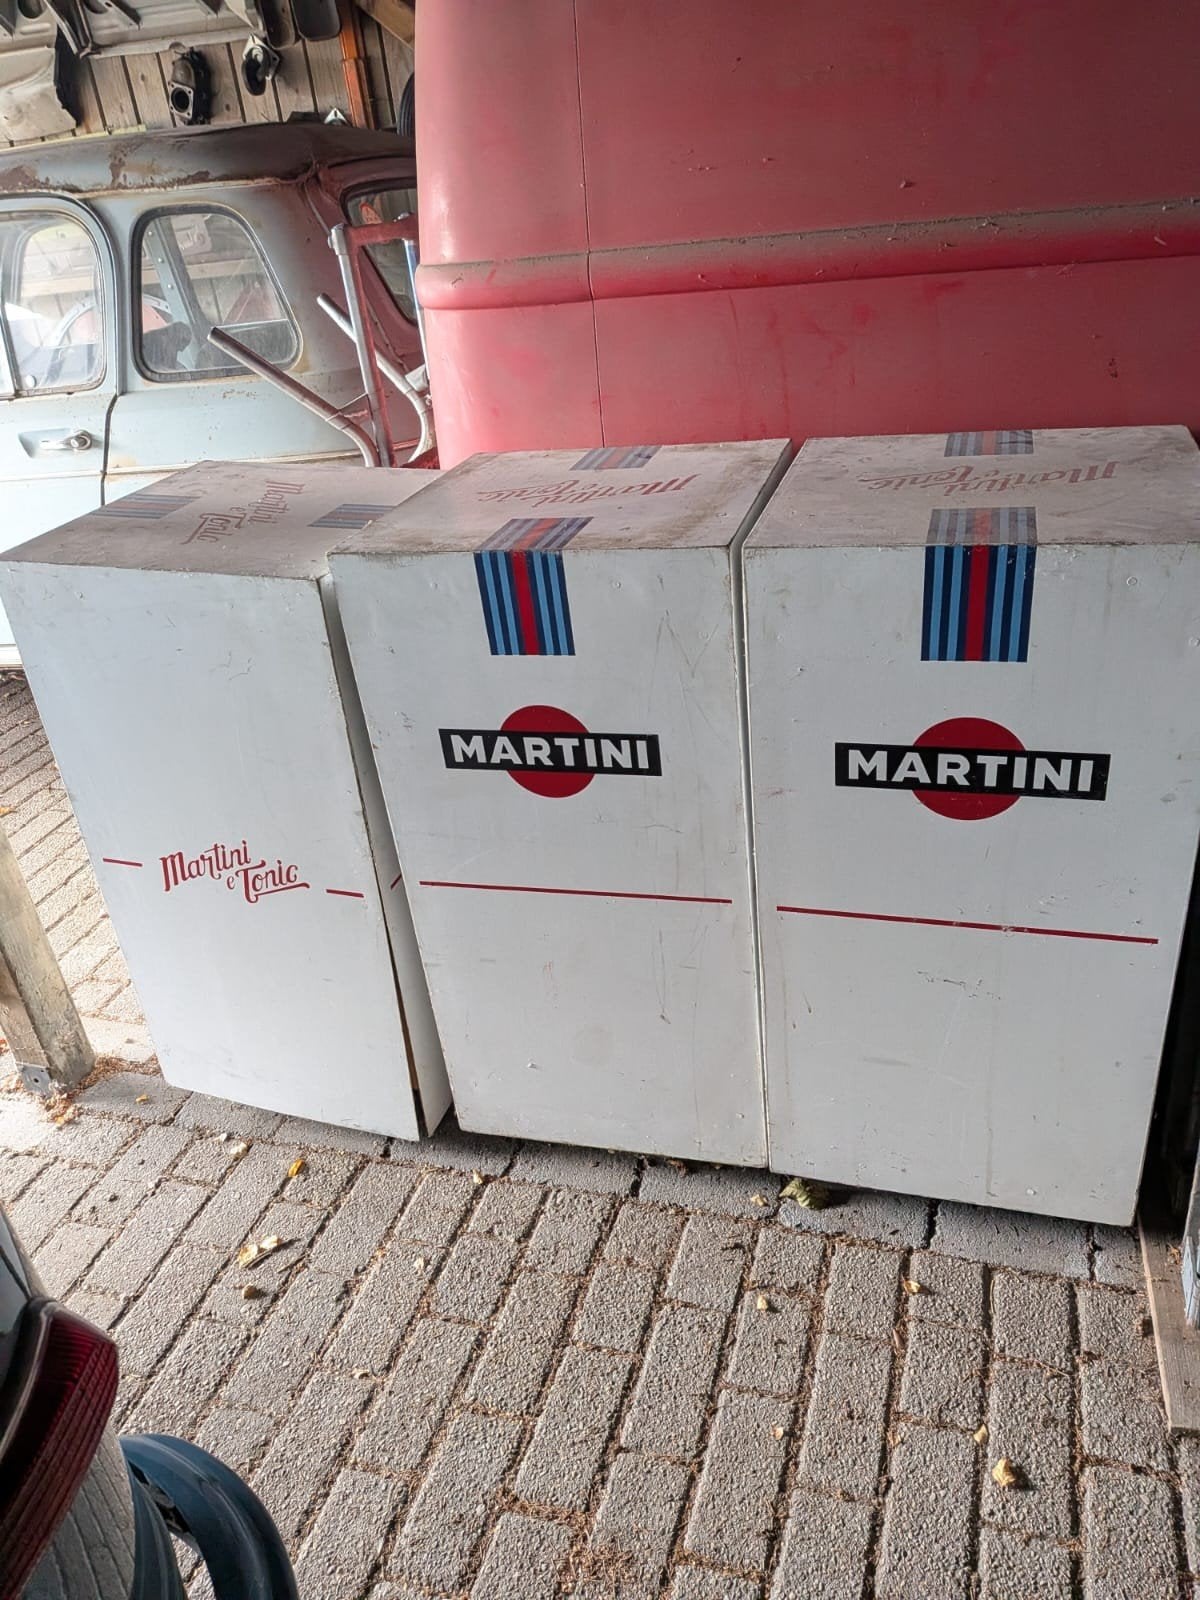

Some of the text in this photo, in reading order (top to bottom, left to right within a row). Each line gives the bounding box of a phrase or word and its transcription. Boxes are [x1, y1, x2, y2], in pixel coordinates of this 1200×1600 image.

[531, 473, 702, 507] Martini
[944, 461, 1120, 496] Martini
[247, 480, 305, 524] Martini
[180, 512, 247, 545] Tonic
[450, 734, 650, 769] MARTINI
[848, 749, 1094, 792] MARTINI
[159, 840, 251, 892] Martini
[226, 859, 310, 904] e Tonic
